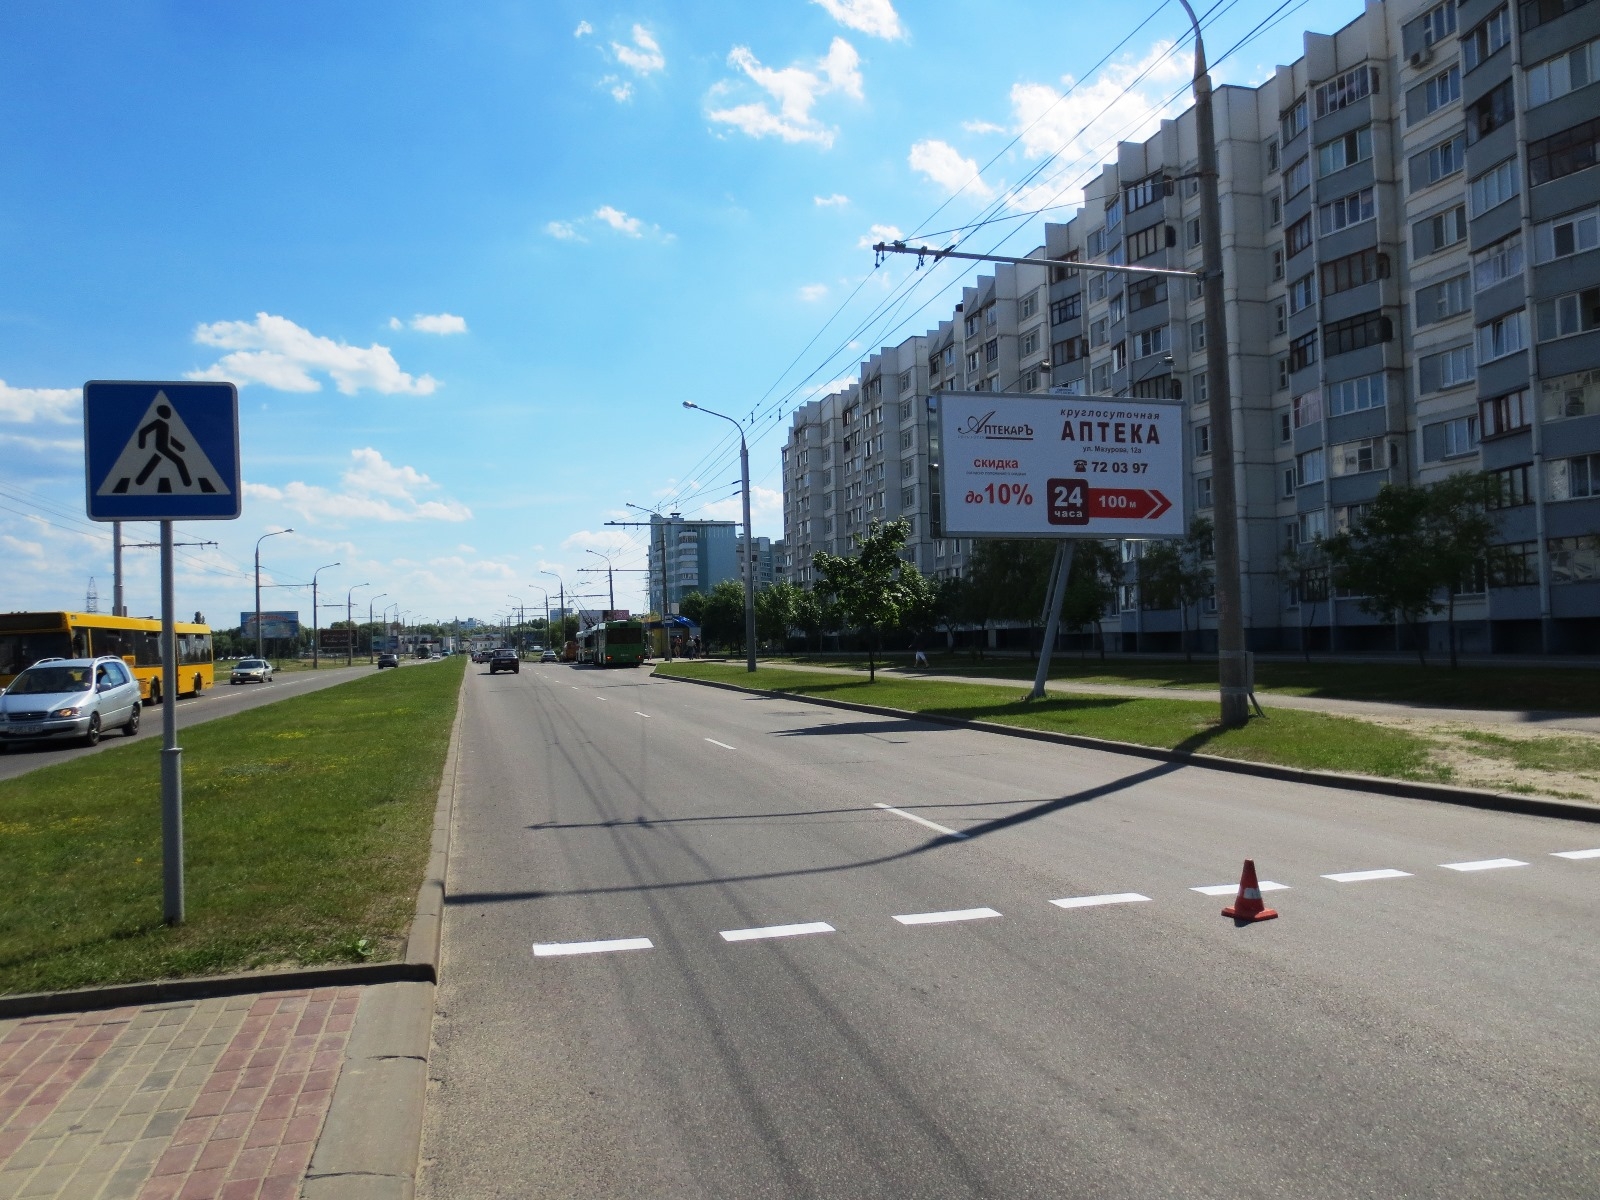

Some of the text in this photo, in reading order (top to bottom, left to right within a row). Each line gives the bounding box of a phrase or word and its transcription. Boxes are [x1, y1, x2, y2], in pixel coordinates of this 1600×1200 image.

[1060, 407, 1160, 420] круглосуточная
[1061, 420, 1160, 445] АПТЕКА
[973, 458, 1019, 470] скидка
[1092, 461, 1149, 474] 72 03 97
[1054, 486, 1083, 507] 24
[1098, 495, 1127, 508] 100
[1054, 510, 1083, 518] часа
